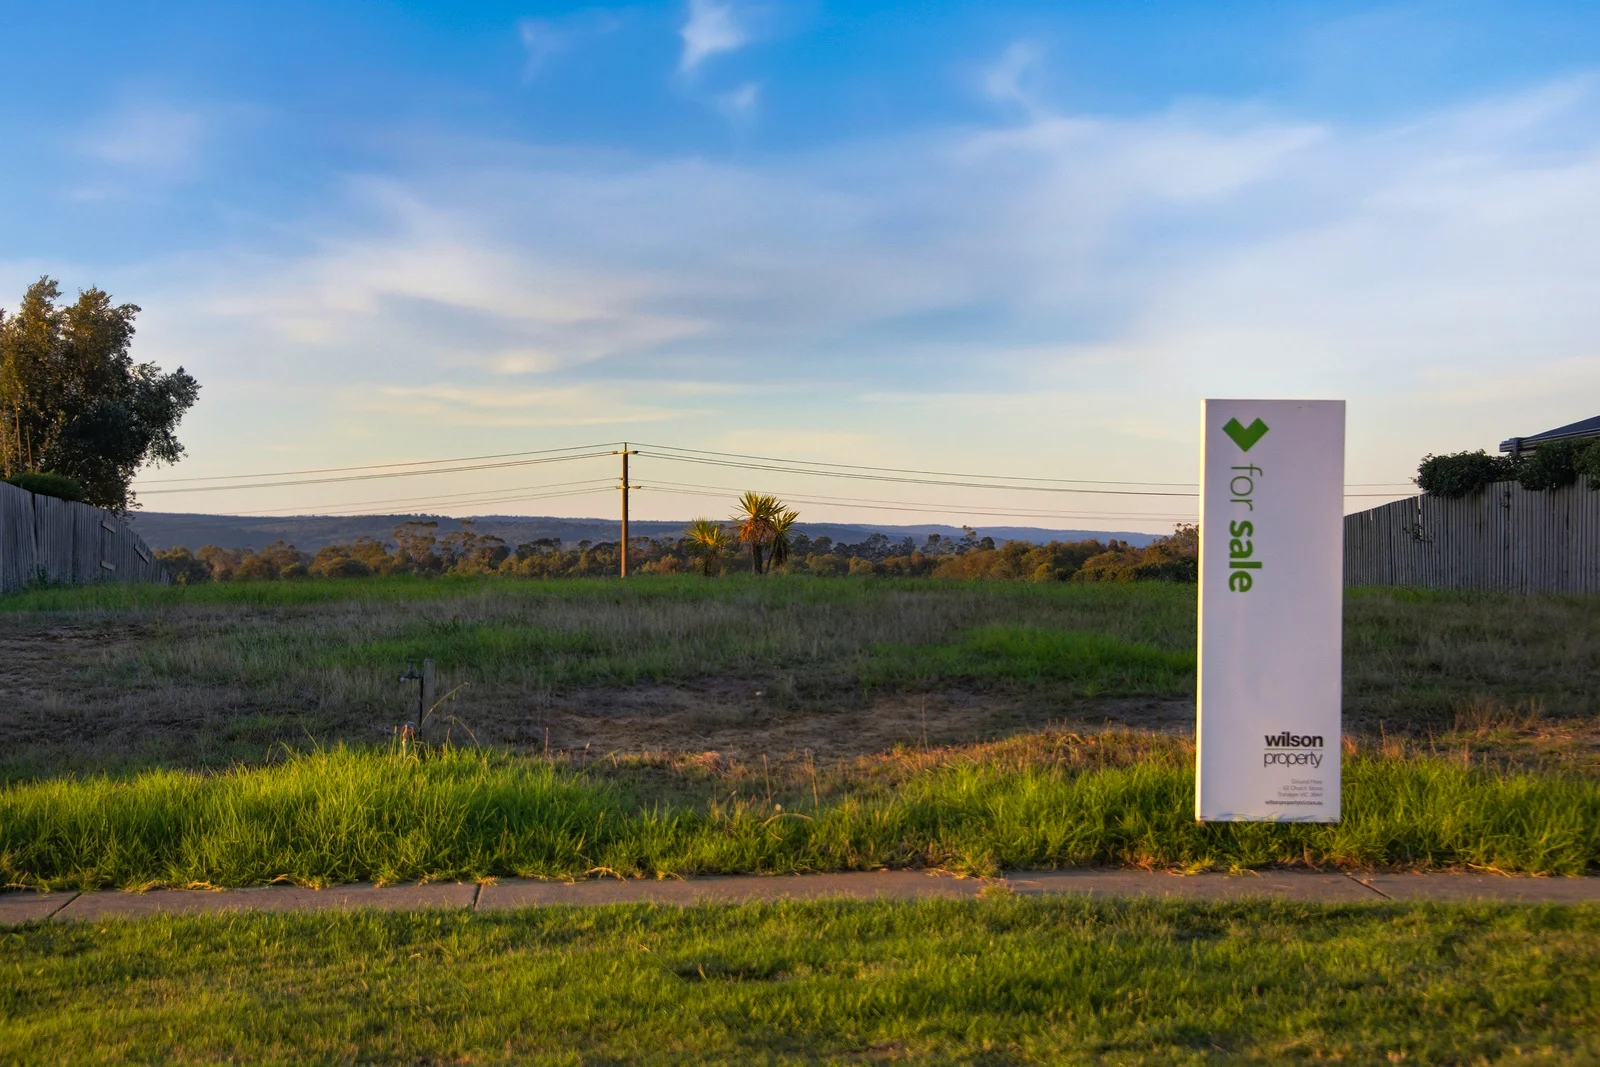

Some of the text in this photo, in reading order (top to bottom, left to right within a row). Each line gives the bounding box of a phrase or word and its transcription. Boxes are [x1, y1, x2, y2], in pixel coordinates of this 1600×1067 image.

[1229, 464, 1263, 592] for sale
[1264, 731, 1323, 747] wilson
[1264, 752, 1323, 768] property
